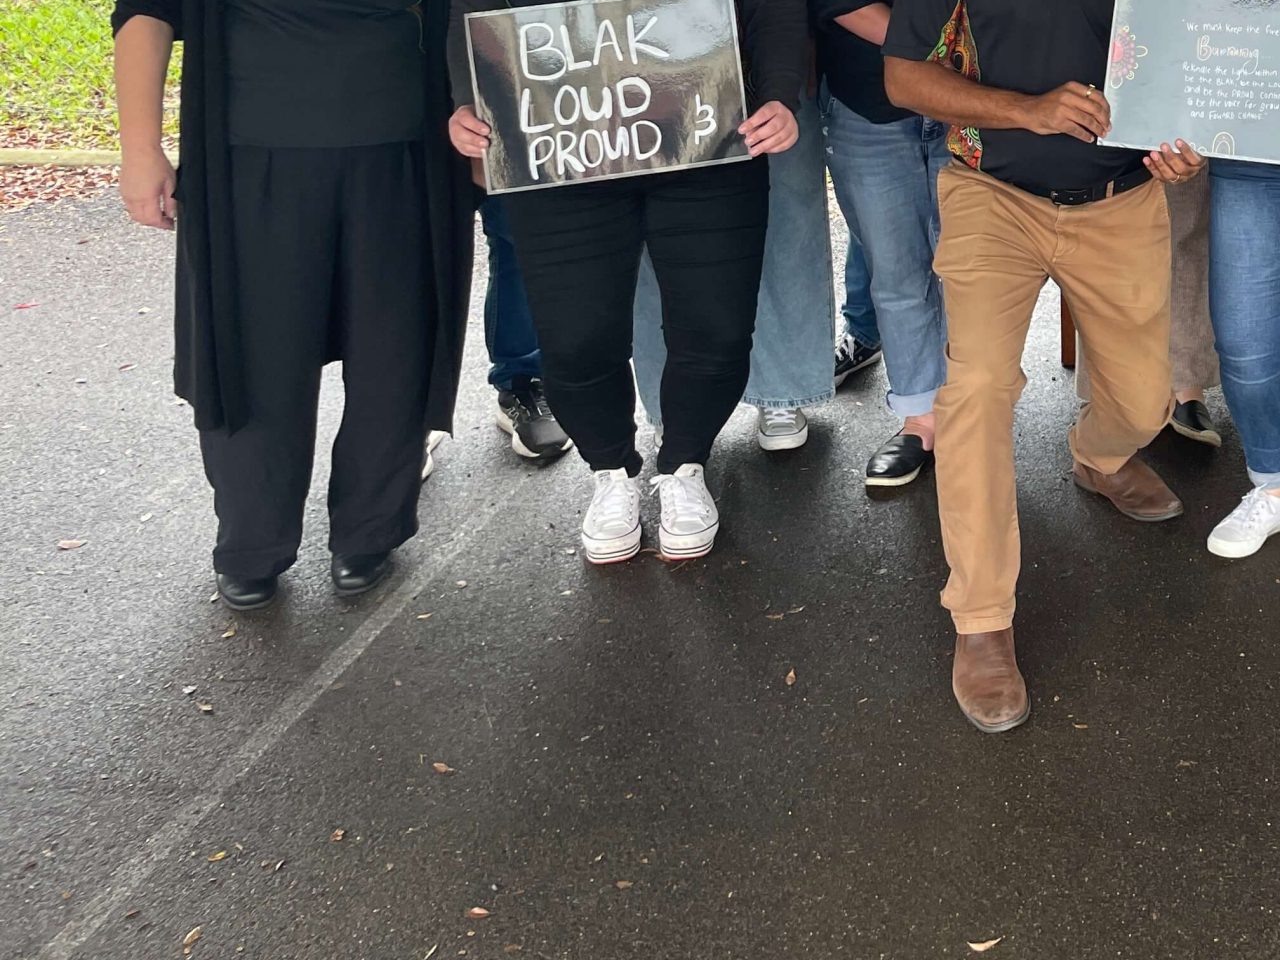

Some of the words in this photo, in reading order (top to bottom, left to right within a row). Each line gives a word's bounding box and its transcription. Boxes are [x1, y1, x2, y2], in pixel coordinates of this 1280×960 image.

[519, 14, 670, 81] BLAK
[1215, 63, 1228, 76] the
[520, 76, 651, 134] LOUD
[528, 120, 662, 180] PROUD
